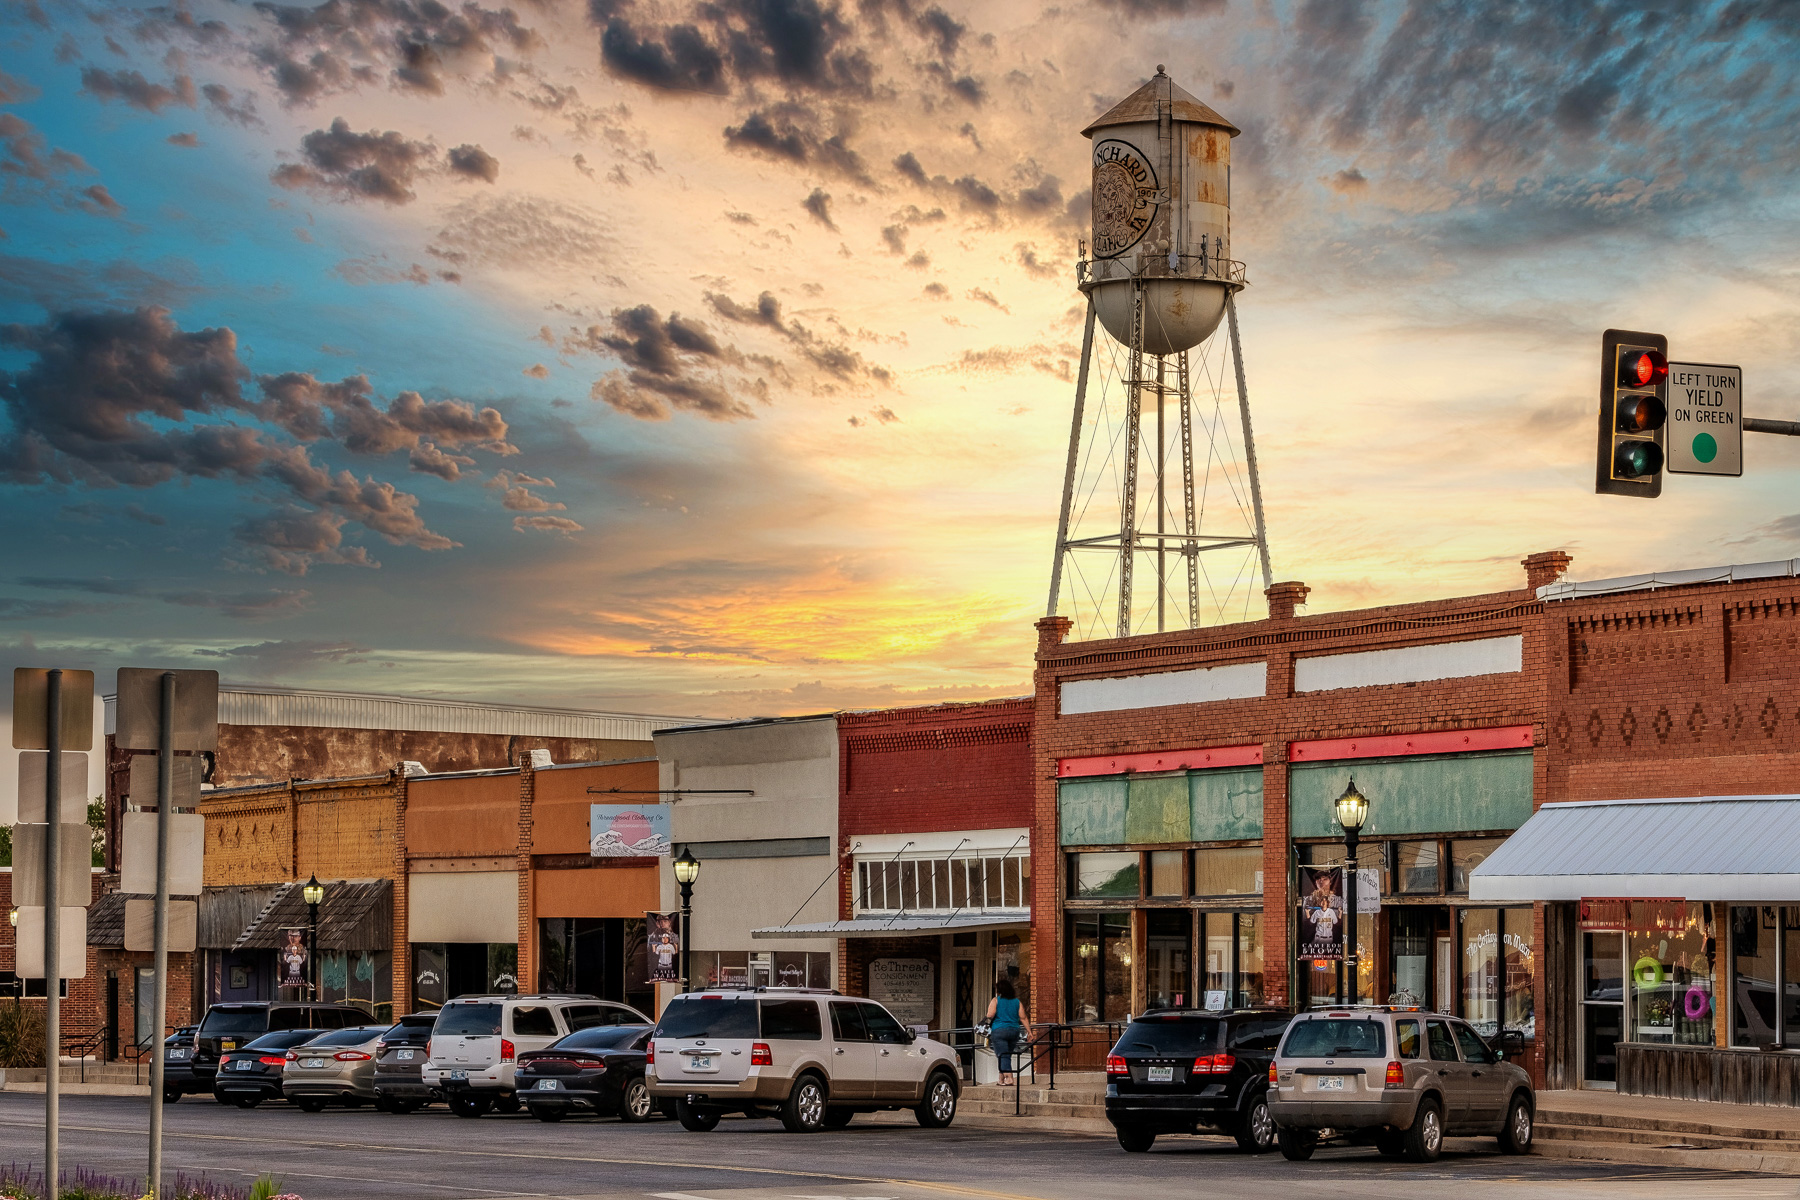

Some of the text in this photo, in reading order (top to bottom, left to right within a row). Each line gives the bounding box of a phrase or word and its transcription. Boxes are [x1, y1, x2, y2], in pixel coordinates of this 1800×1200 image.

[1137, 190, 1156, 199] 1907
[1673, 372, 1736, 389] LEFT TURN
[1686, 389, 1723, 407] YIELD
[1675, 409, 1734, 424] ON GREEN
[632, 814, 654, 822] Clothing
[1466, 942, 1478, 959] The
[1503, 933, 1512, 946] on
[1513, 933, 1531, 960] Main
[874, 961, 929, 972] ReThread
